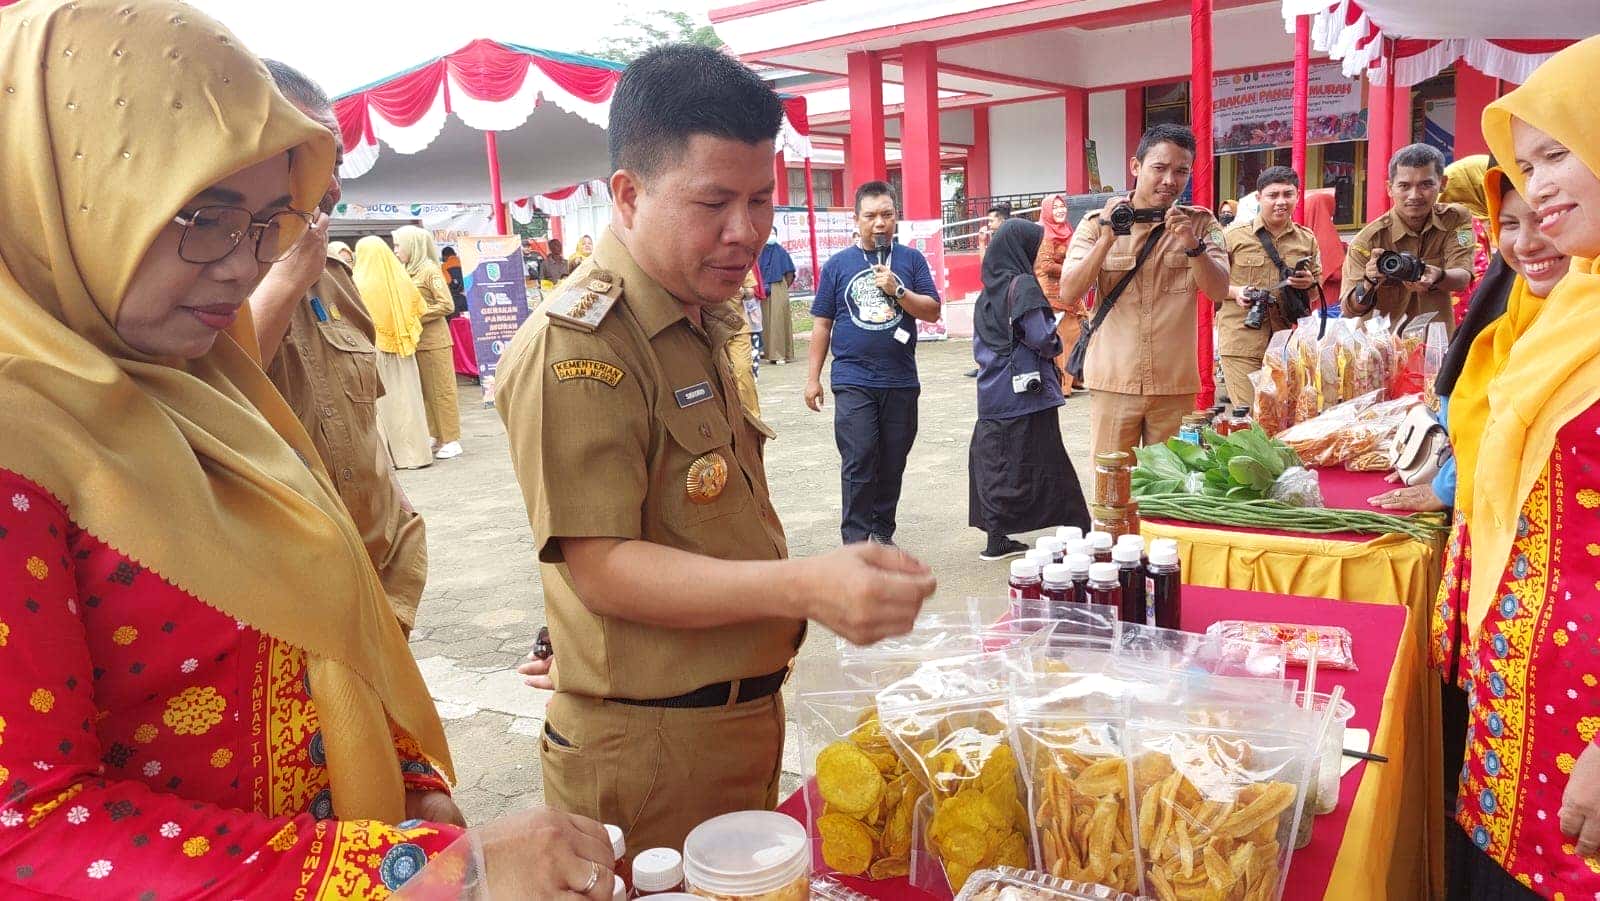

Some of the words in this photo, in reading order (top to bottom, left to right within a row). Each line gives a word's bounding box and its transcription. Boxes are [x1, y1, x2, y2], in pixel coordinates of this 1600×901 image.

[1213, 92, 1256, 109] ERAKAN
[1259, 87, 1294, 101] PANGA
[1309, 82, 1352, 96] MURAH
[556, 359, 619, 377] KEMENTERIAN
[559, 368, 587, 377] DALAM
[590, 369, 617, 385] NEGERI
[1555, 463, 1564, 513] SAMBAS
[1553, 538, 1563, 563] PKK
[1551, 567, 1560, 592] KAB
[1537, 595, 1555, 643] SAMBAS
[1529, 665, 1537, 688] PKK
[252, 661, 263, 737] SAMBAS
[1525, 718, 1535, 765] SAMBAS
[251, 742, 263, 768] TP
[253, 776, 264, 817] PKK
